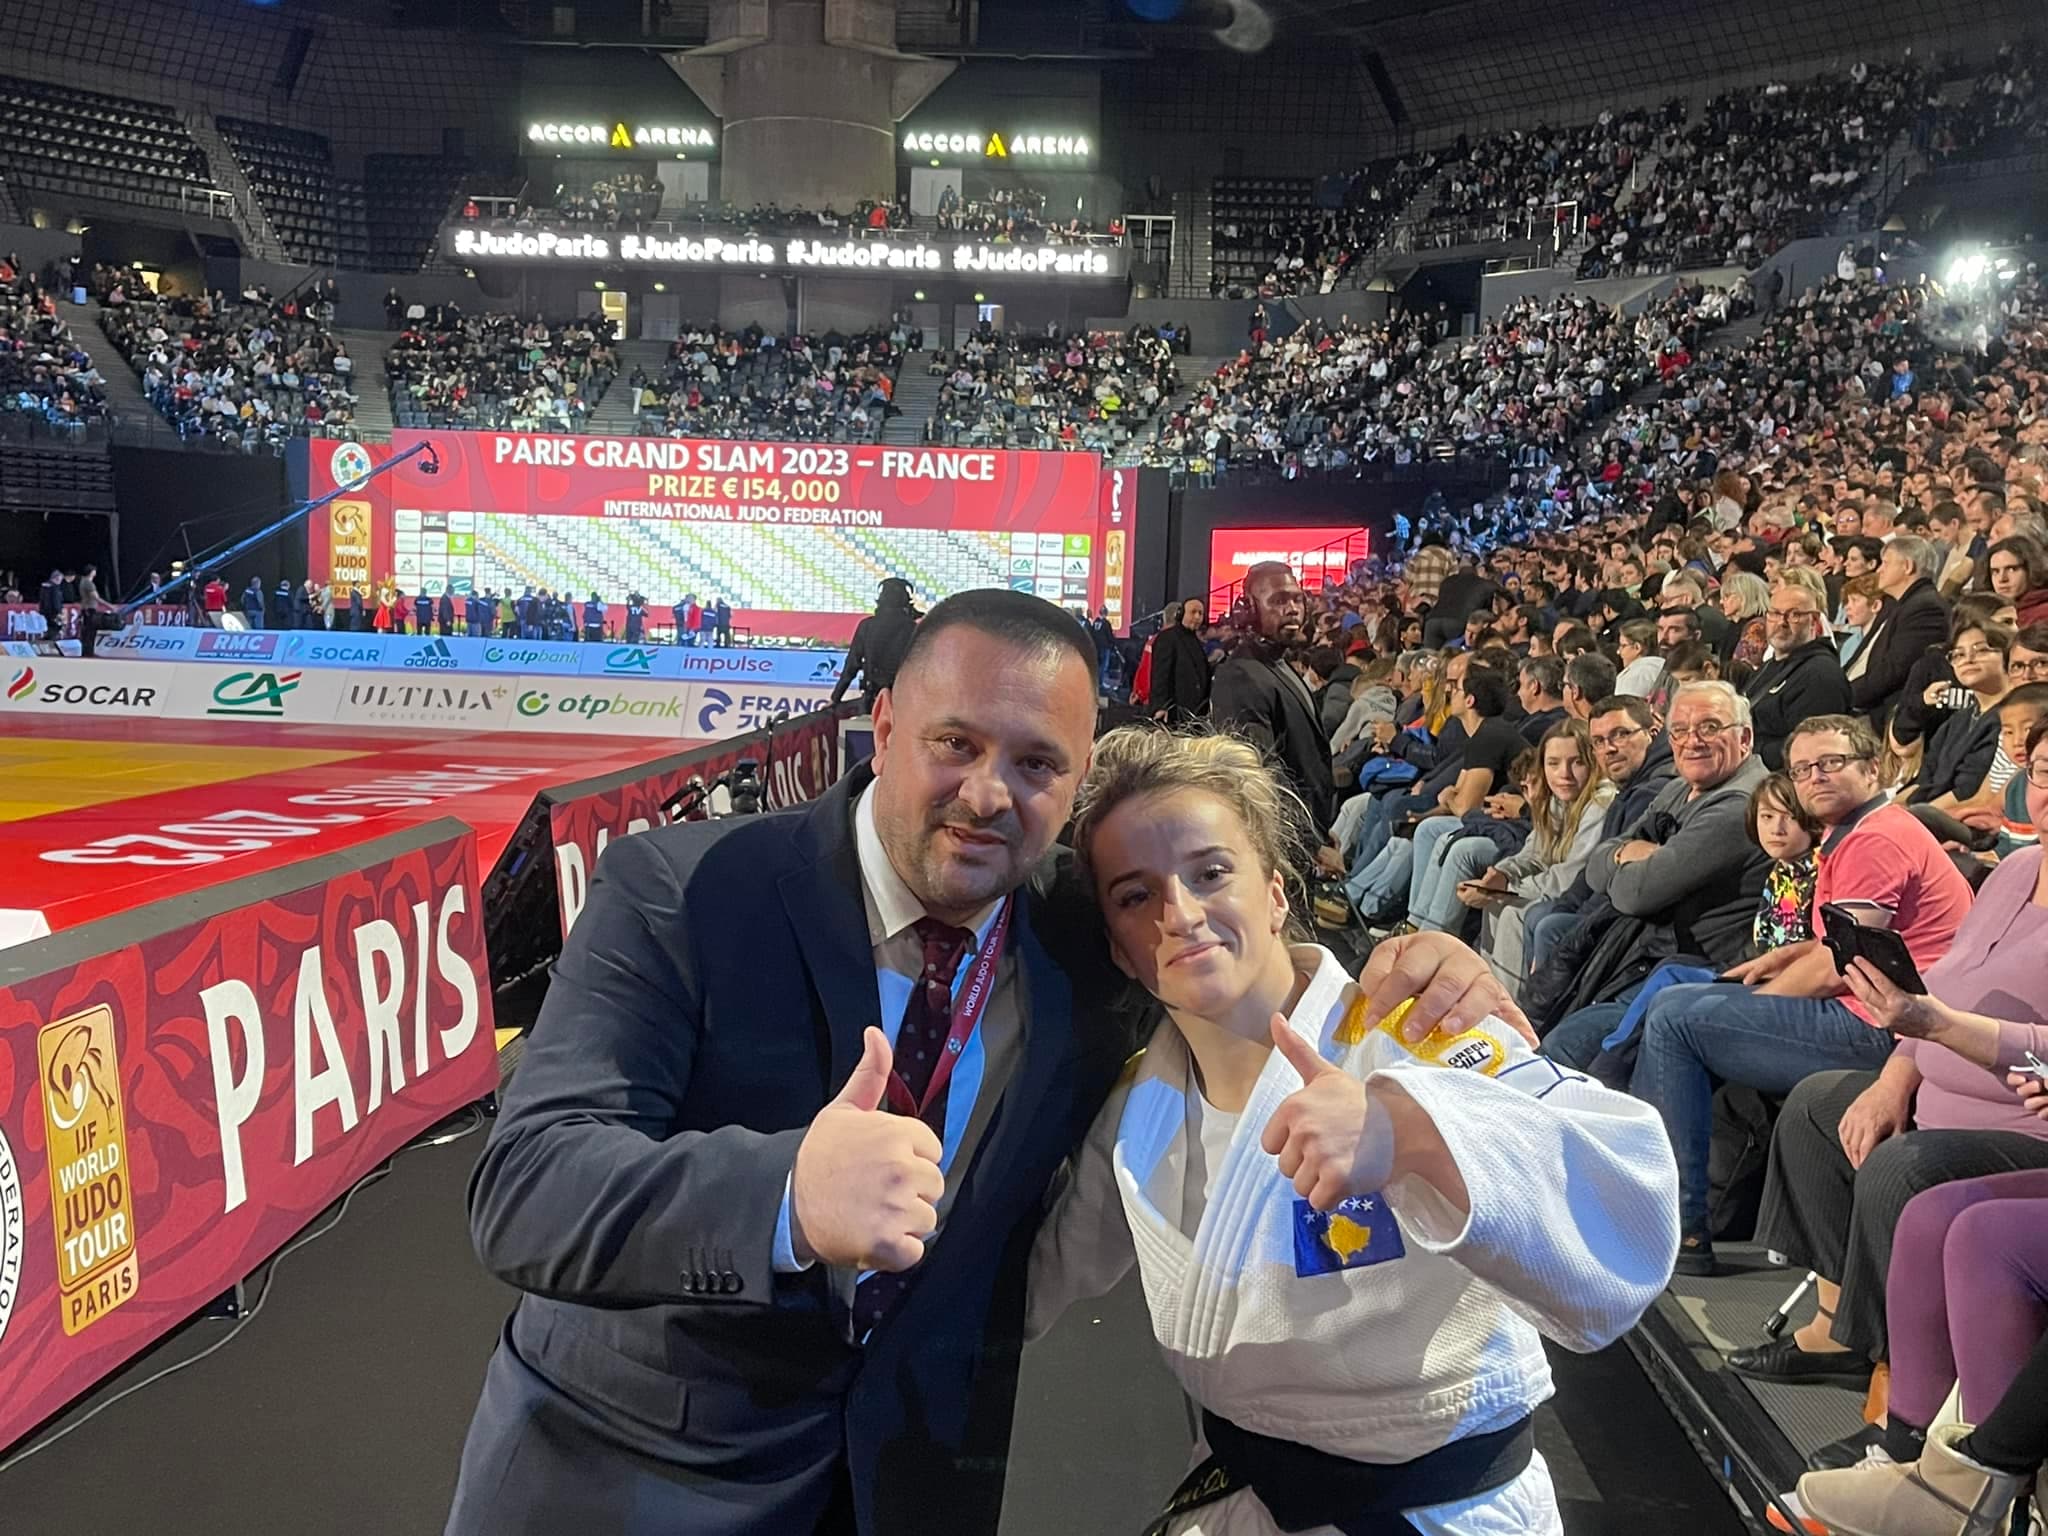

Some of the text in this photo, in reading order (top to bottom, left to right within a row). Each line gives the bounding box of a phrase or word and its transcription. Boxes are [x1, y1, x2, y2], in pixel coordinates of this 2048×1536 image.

[528, 123, 607, 144] ACCOR
[635, 126, 714, 146] ARENA
[903, 133, 980, 153] ACCOR
[1010, 135, 1089, 155] ARENA
[455, 230, 1108, 274] #JudoParis #JudoParis #JudoParis #JudoParis
[495, 437, 576, 467] PARIS
[584, 440, 690, 470] GRAND
[697, 444, 774, 473] SLAM
[781, 447, 849, 475] 2023
[882, 451, 995, 480] FRANCE
[649, 474, 716, 499] PRIZE
[604, 500, 882, 525] INTERNATIONAL JUDO FEDERATION
[334, 555, 367, 569] JUDO
[335, 545, 368, 556] WORLD
[334, 567, 368, 582] TOUR
[96, 633, 185, 651] TaiShan
[213, 633, 264, 651] RMC
[309, 647, 381, 662] SOCAR
[404, 655, 458, 668] adidas
[508, 648, 578, 665] otpbank
[683, 653, 774, 674] impulse
[40, 683, 157, 706] SOCAR
[350, 685, 492, 710] ULTIMA
[558, 691, 683, 720] otpbank
[39, 809, 364, 866] 2023
[963, 936, 999, 1017] WORLD JUDO TOUR
[199, 884, 479, 1214] PARIS
[1448, 1039, 1489, 1065] GREEN
[76, 1120, 97, 1155] IJF
[59, 1142, 119, 1194] WORLD
[64, 1173, 122, 1237] JUDO
[63, 1212, 128, 1277] TOUR
[72, 1266, 132, 1327] PARIS
